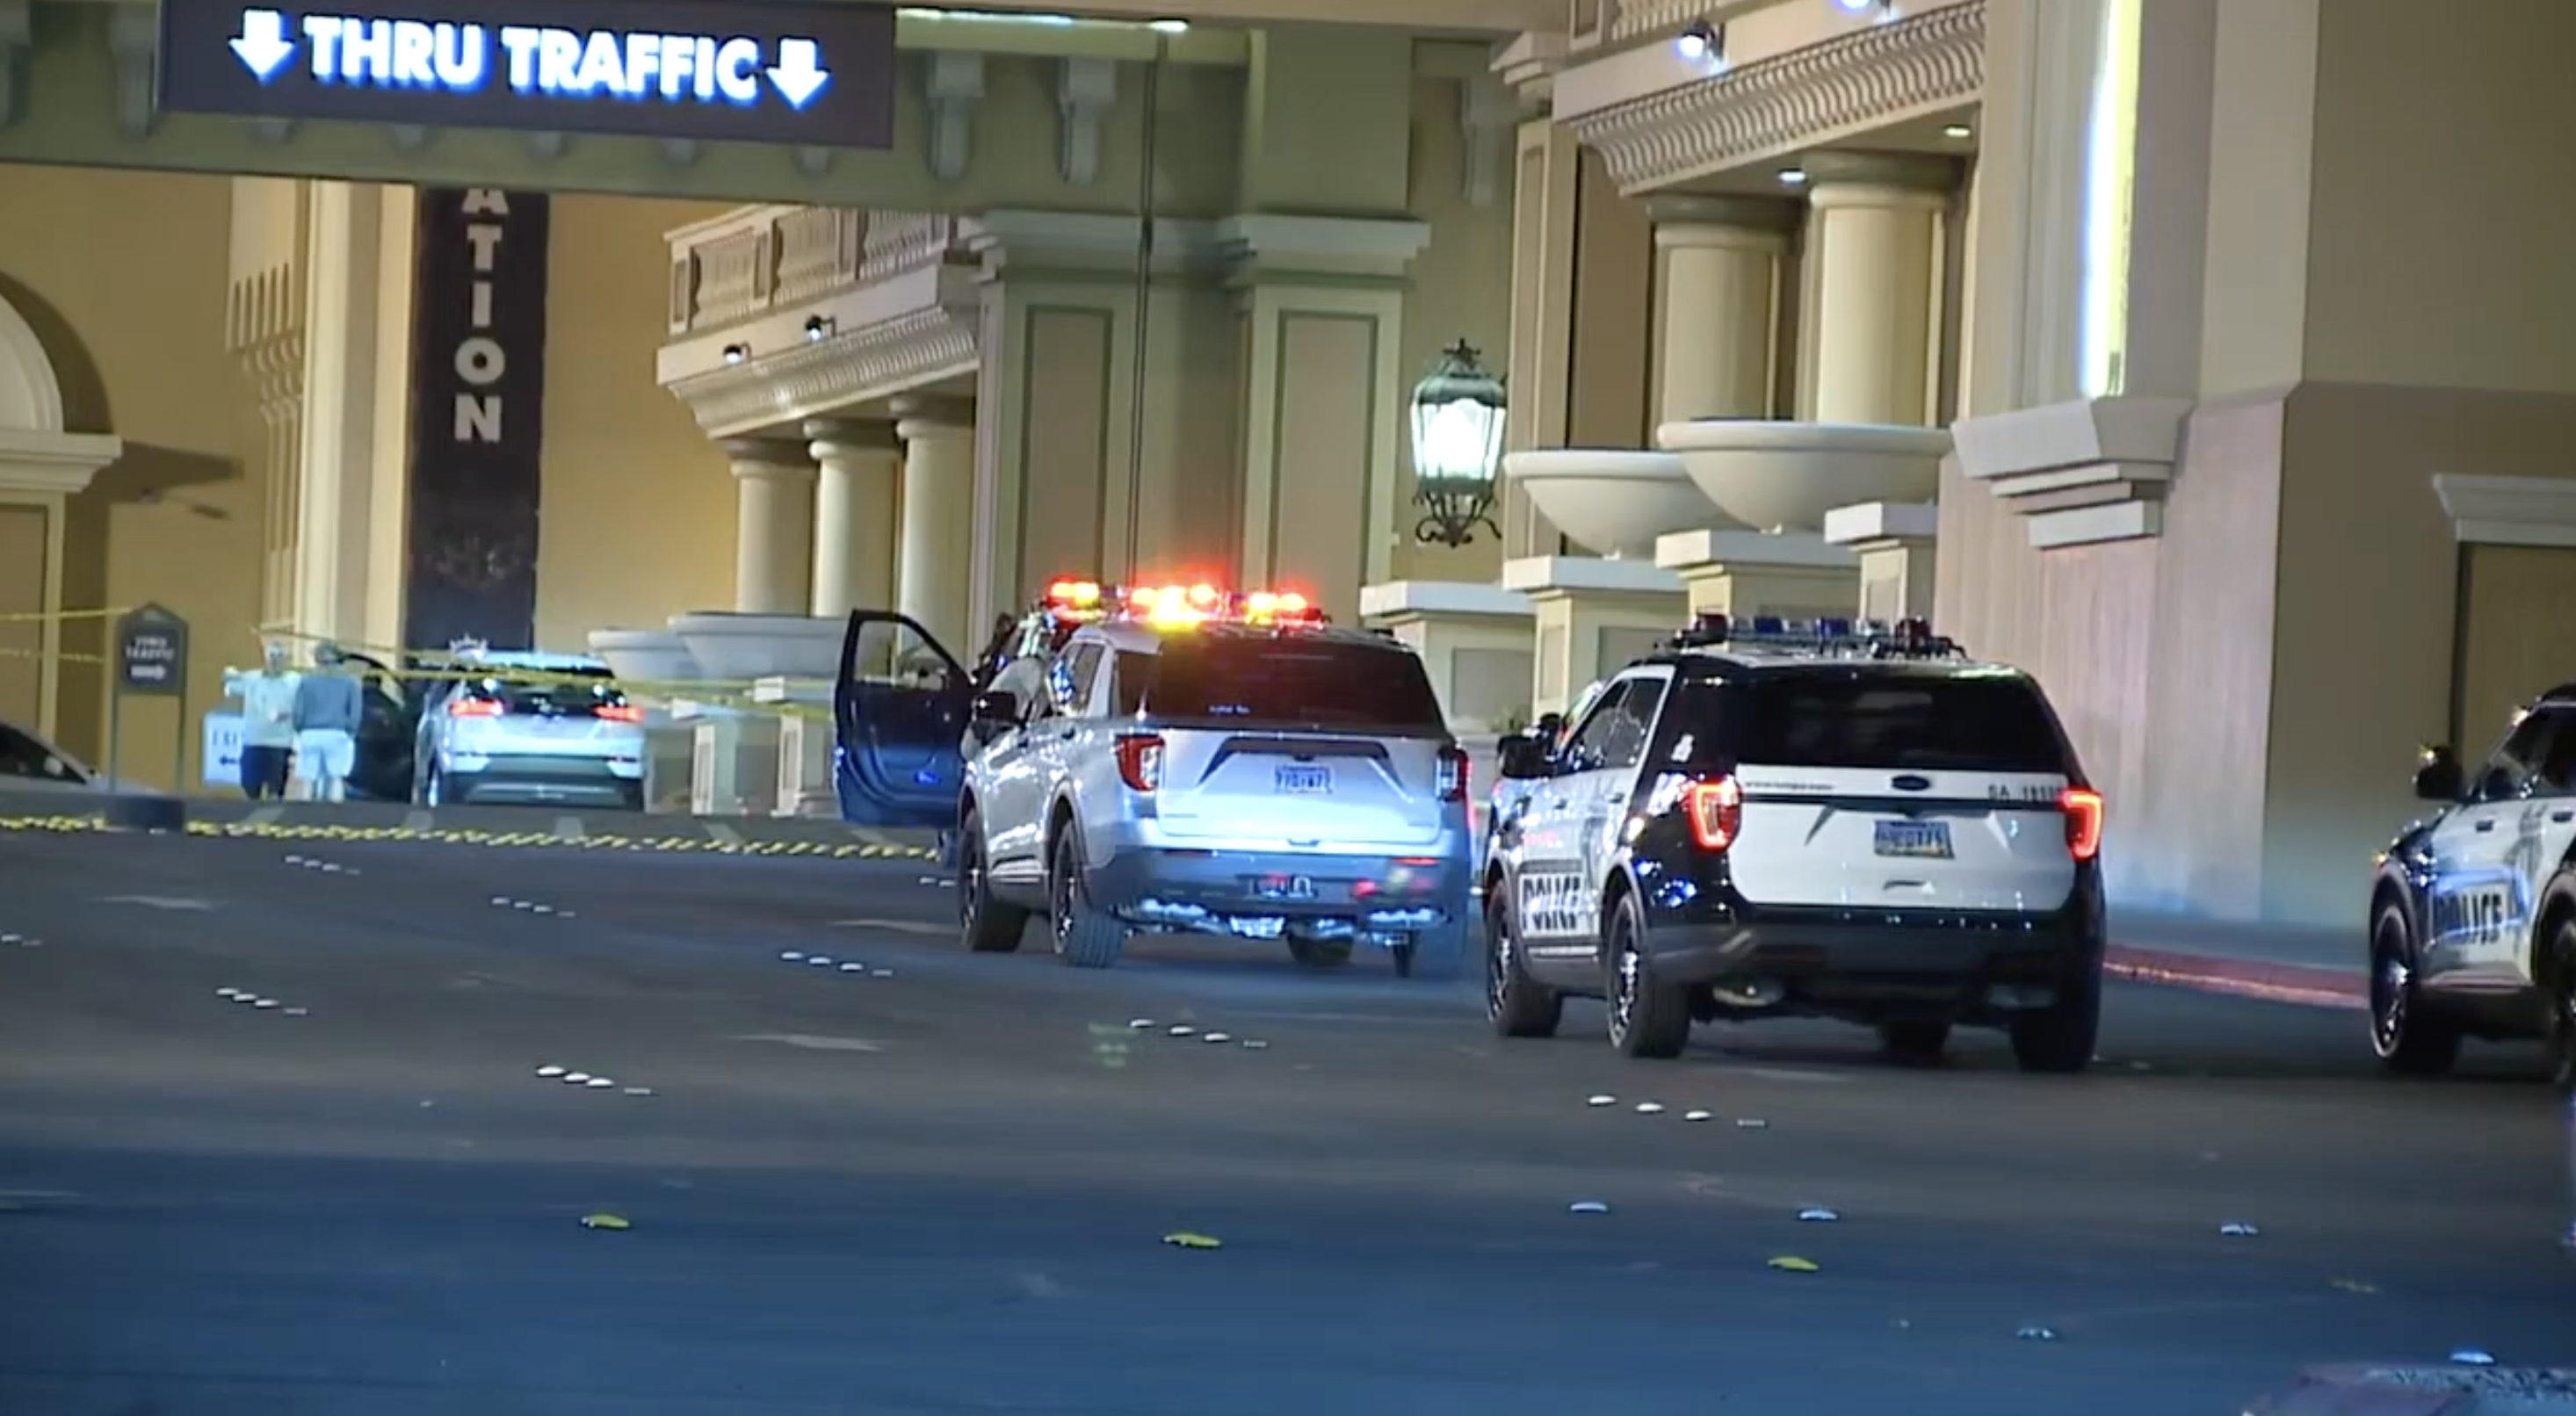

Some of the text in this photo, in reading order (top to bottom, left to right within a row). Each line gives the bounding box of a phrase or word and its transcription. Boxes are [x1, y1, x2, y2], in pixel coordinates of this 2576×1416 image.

[302, 15, 760, 103] THRU TRAFFIC
[453, 187, 510, 442] ATION
